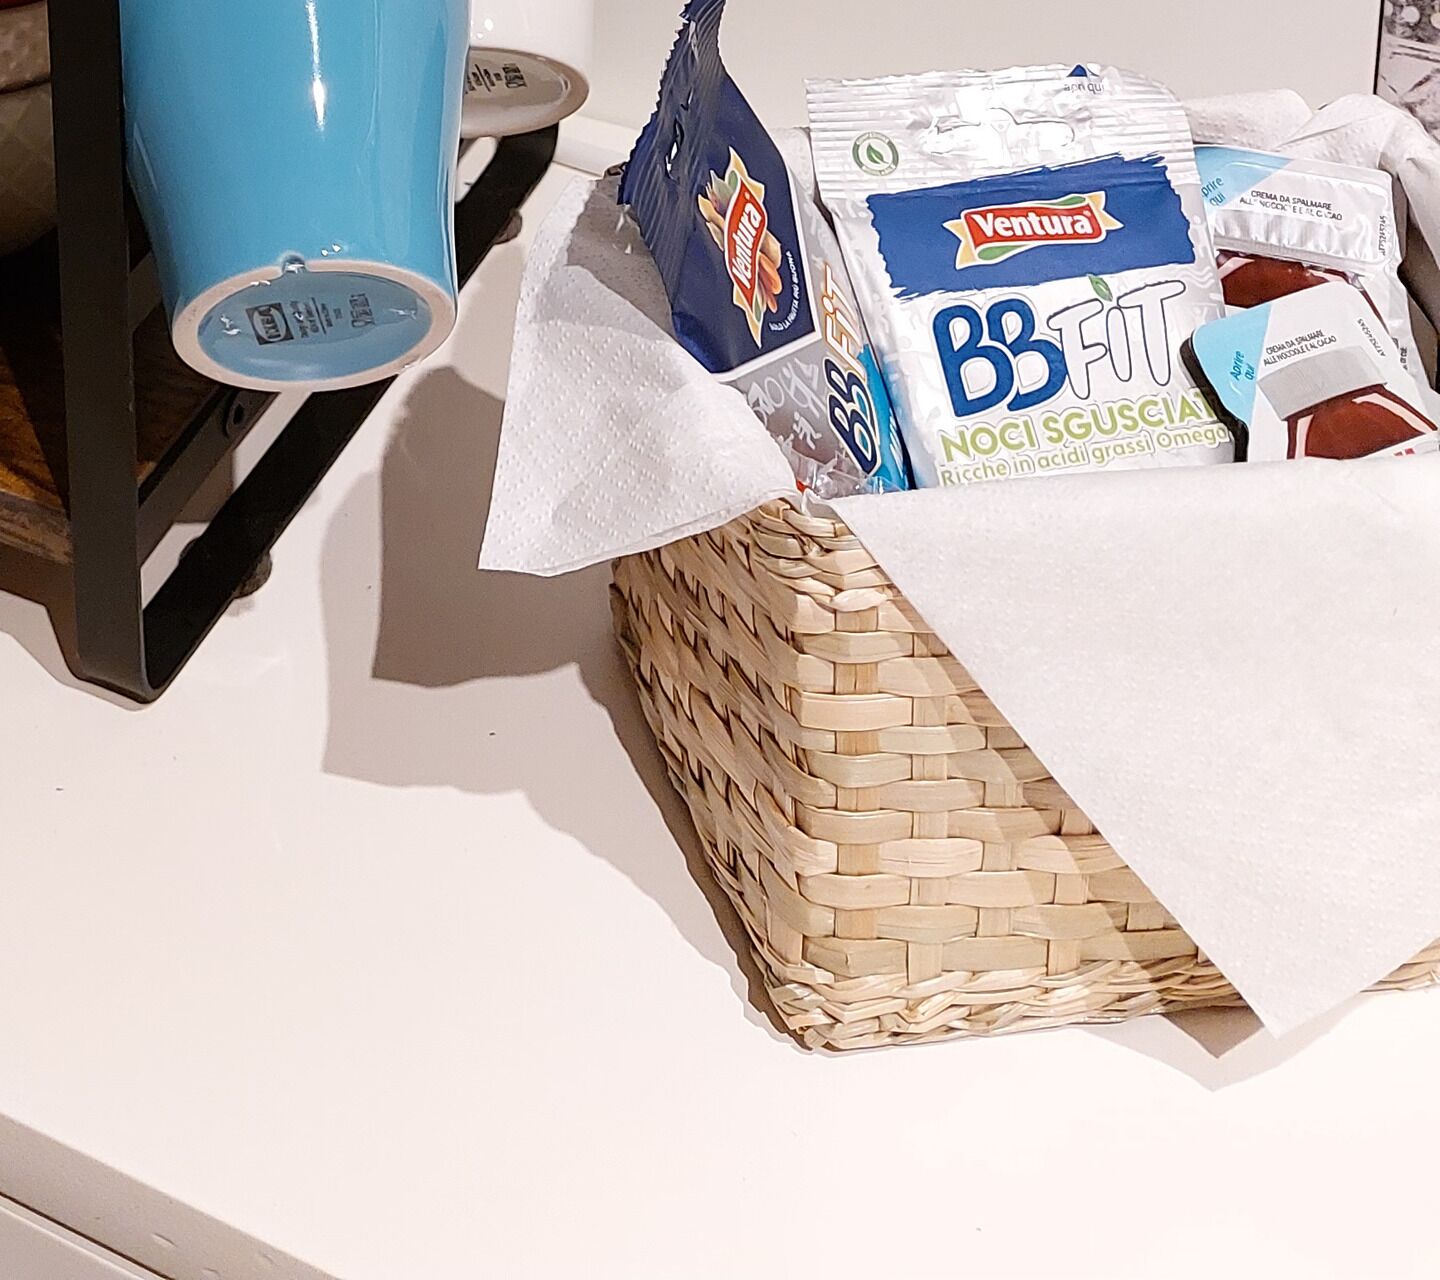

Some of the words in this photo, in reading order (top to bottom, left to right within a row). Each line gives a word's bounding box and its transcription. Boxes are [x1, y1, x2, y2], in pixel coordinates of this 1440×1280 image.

[1200, 177, 1225, 199] prire
[1251, 190, 1277, 203] CREMA
[1279, 195, 1291, 204] DA
[1292, 197, 1332, 212] SPALMARE
[975, 210, 1093, 240] Ventura
[732, 202, 763, 290] Ventura
[1263, 354, 1277, 367] ALLE
[1317, 335, 1337, 349] CACAO
[1265, 342, 1284, 356] CREMA
[1284, 339, 1294, 351] DA
[1294, 329, 1325, 348] SPALMARE
[1229, 350, 1246, 382] Aprire
[941, 418, 1037, 463] NOCI
[941, 455, 1009, 487] Ricche
[1015, 454, 1034, 474] in
[1037, 443, 1087, 471] acidi
[1092, 434, 1150, 466] grassi
